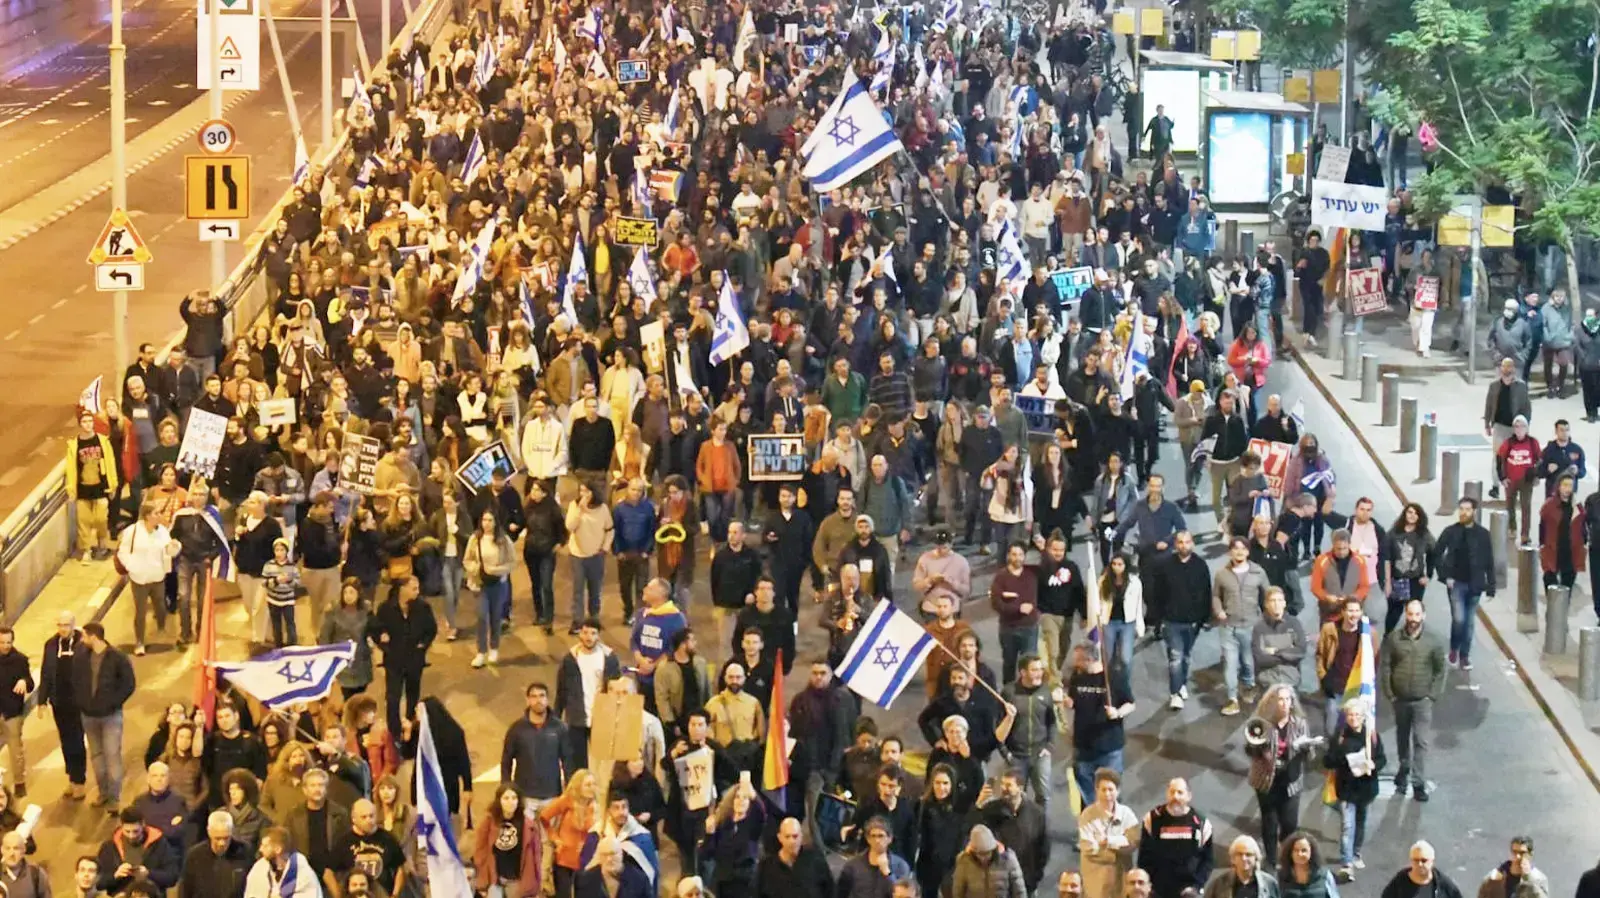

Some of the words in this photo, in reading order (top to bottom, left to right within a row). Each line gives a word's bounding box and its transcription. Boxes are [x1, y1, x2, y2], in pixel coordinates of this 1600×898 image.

[207, 131, 227, 145] 30
[1321, 197, 1358, 213] עתיד
[1361, 201, 1380, 214] יש
